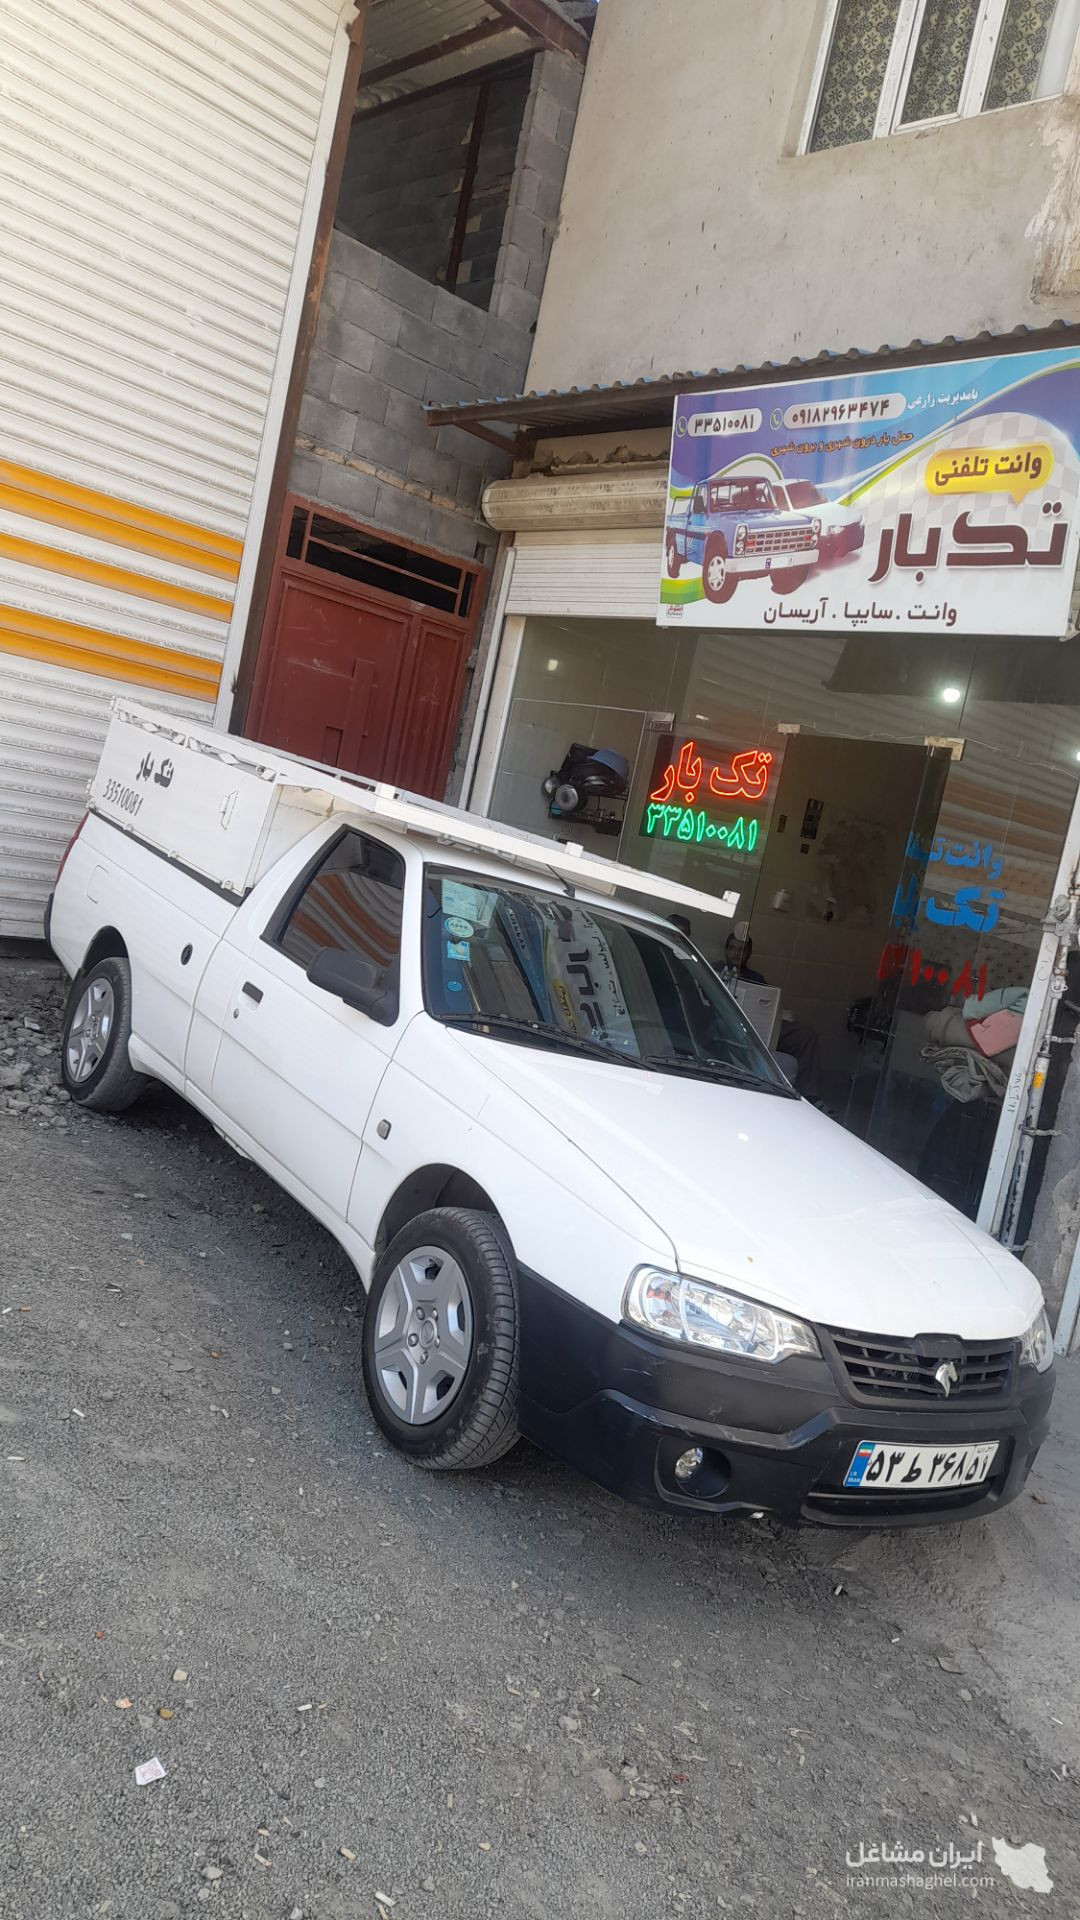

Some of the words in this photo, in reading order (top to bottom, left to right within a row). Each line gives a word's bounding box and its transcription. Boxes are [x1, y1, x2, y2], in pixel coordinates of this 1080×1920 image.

[694, 414, 754, 433] ۳۳۵۱۰۰۸۱
[792, 399, 890, 424] ۰۹۱۸۲۹۶۳۴۷۴
[770, 441, 796, 457] شهری
[796, 442, 817, 454] برون
[825, 436, 851, 452] شهری
[851, 435, 876, 450] درون
[877, 432, 892, 447] بار
[892, 430, 914, 445] حمل
[935, 457, 989, 486] تلفنی
[994, 454, 1042, 480] وانت
[763, 597, 829, 624] آریسان
[844, 602, 893, 628] سایپا
[907, 602, 957, 626] وانت
[136, 751, 155, 782] بار
[650, 741, 702, 803] بار
[710, 750, 773, 799] تک
[102, 778, 144, 817] 33510081
[646, 802, 758, 852] ۳۳۵۱۰۰۸۱
[925, 885, 1006, 932] تک
[866, 1450, 906, 1483] ۵۳
[928, 1451, 968, 1483] ۳۶۸
